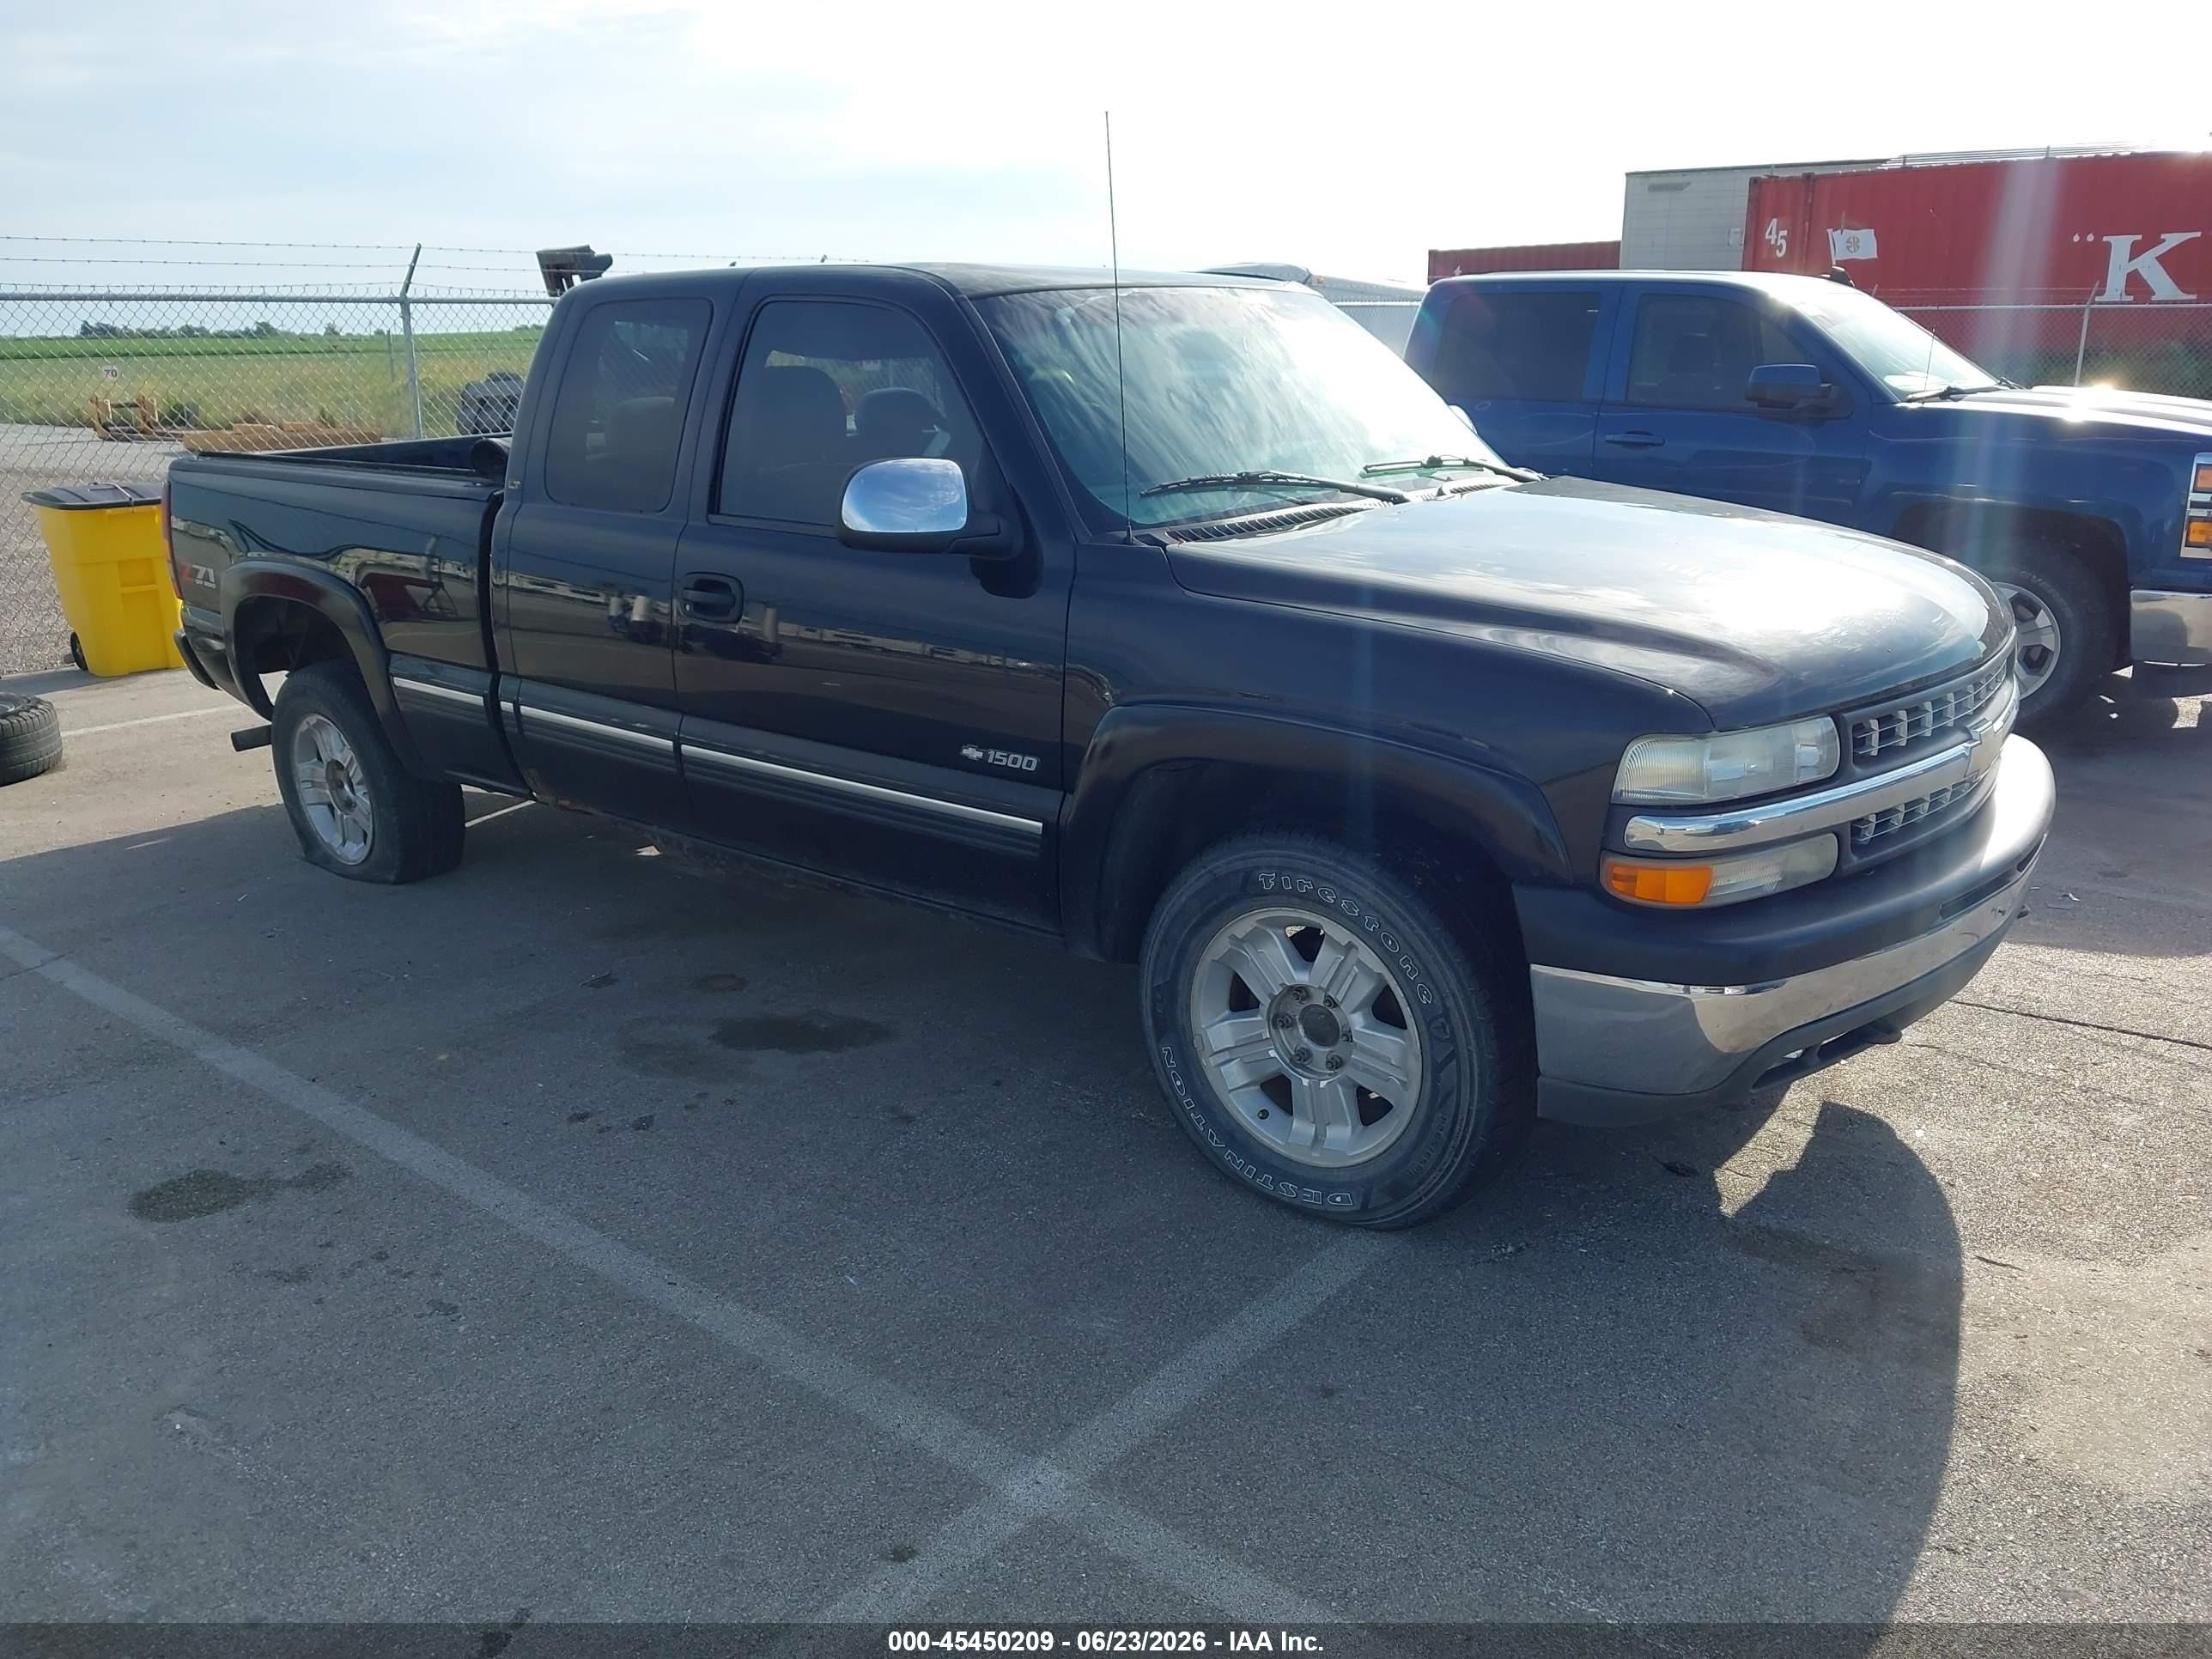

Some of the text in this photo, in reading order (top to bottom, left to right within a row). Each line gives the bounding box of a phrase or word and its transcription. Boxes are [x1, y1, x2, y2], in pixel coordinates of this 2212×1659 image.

[1765, 218, 1788, 258] 45
[104, 369, 118, 378] 70
[988, 750, 1038, 772] 1500
[1258, 872, 1433, 1005] Firestone
[1161, 1046, 1354, 1206] DESTINATION
